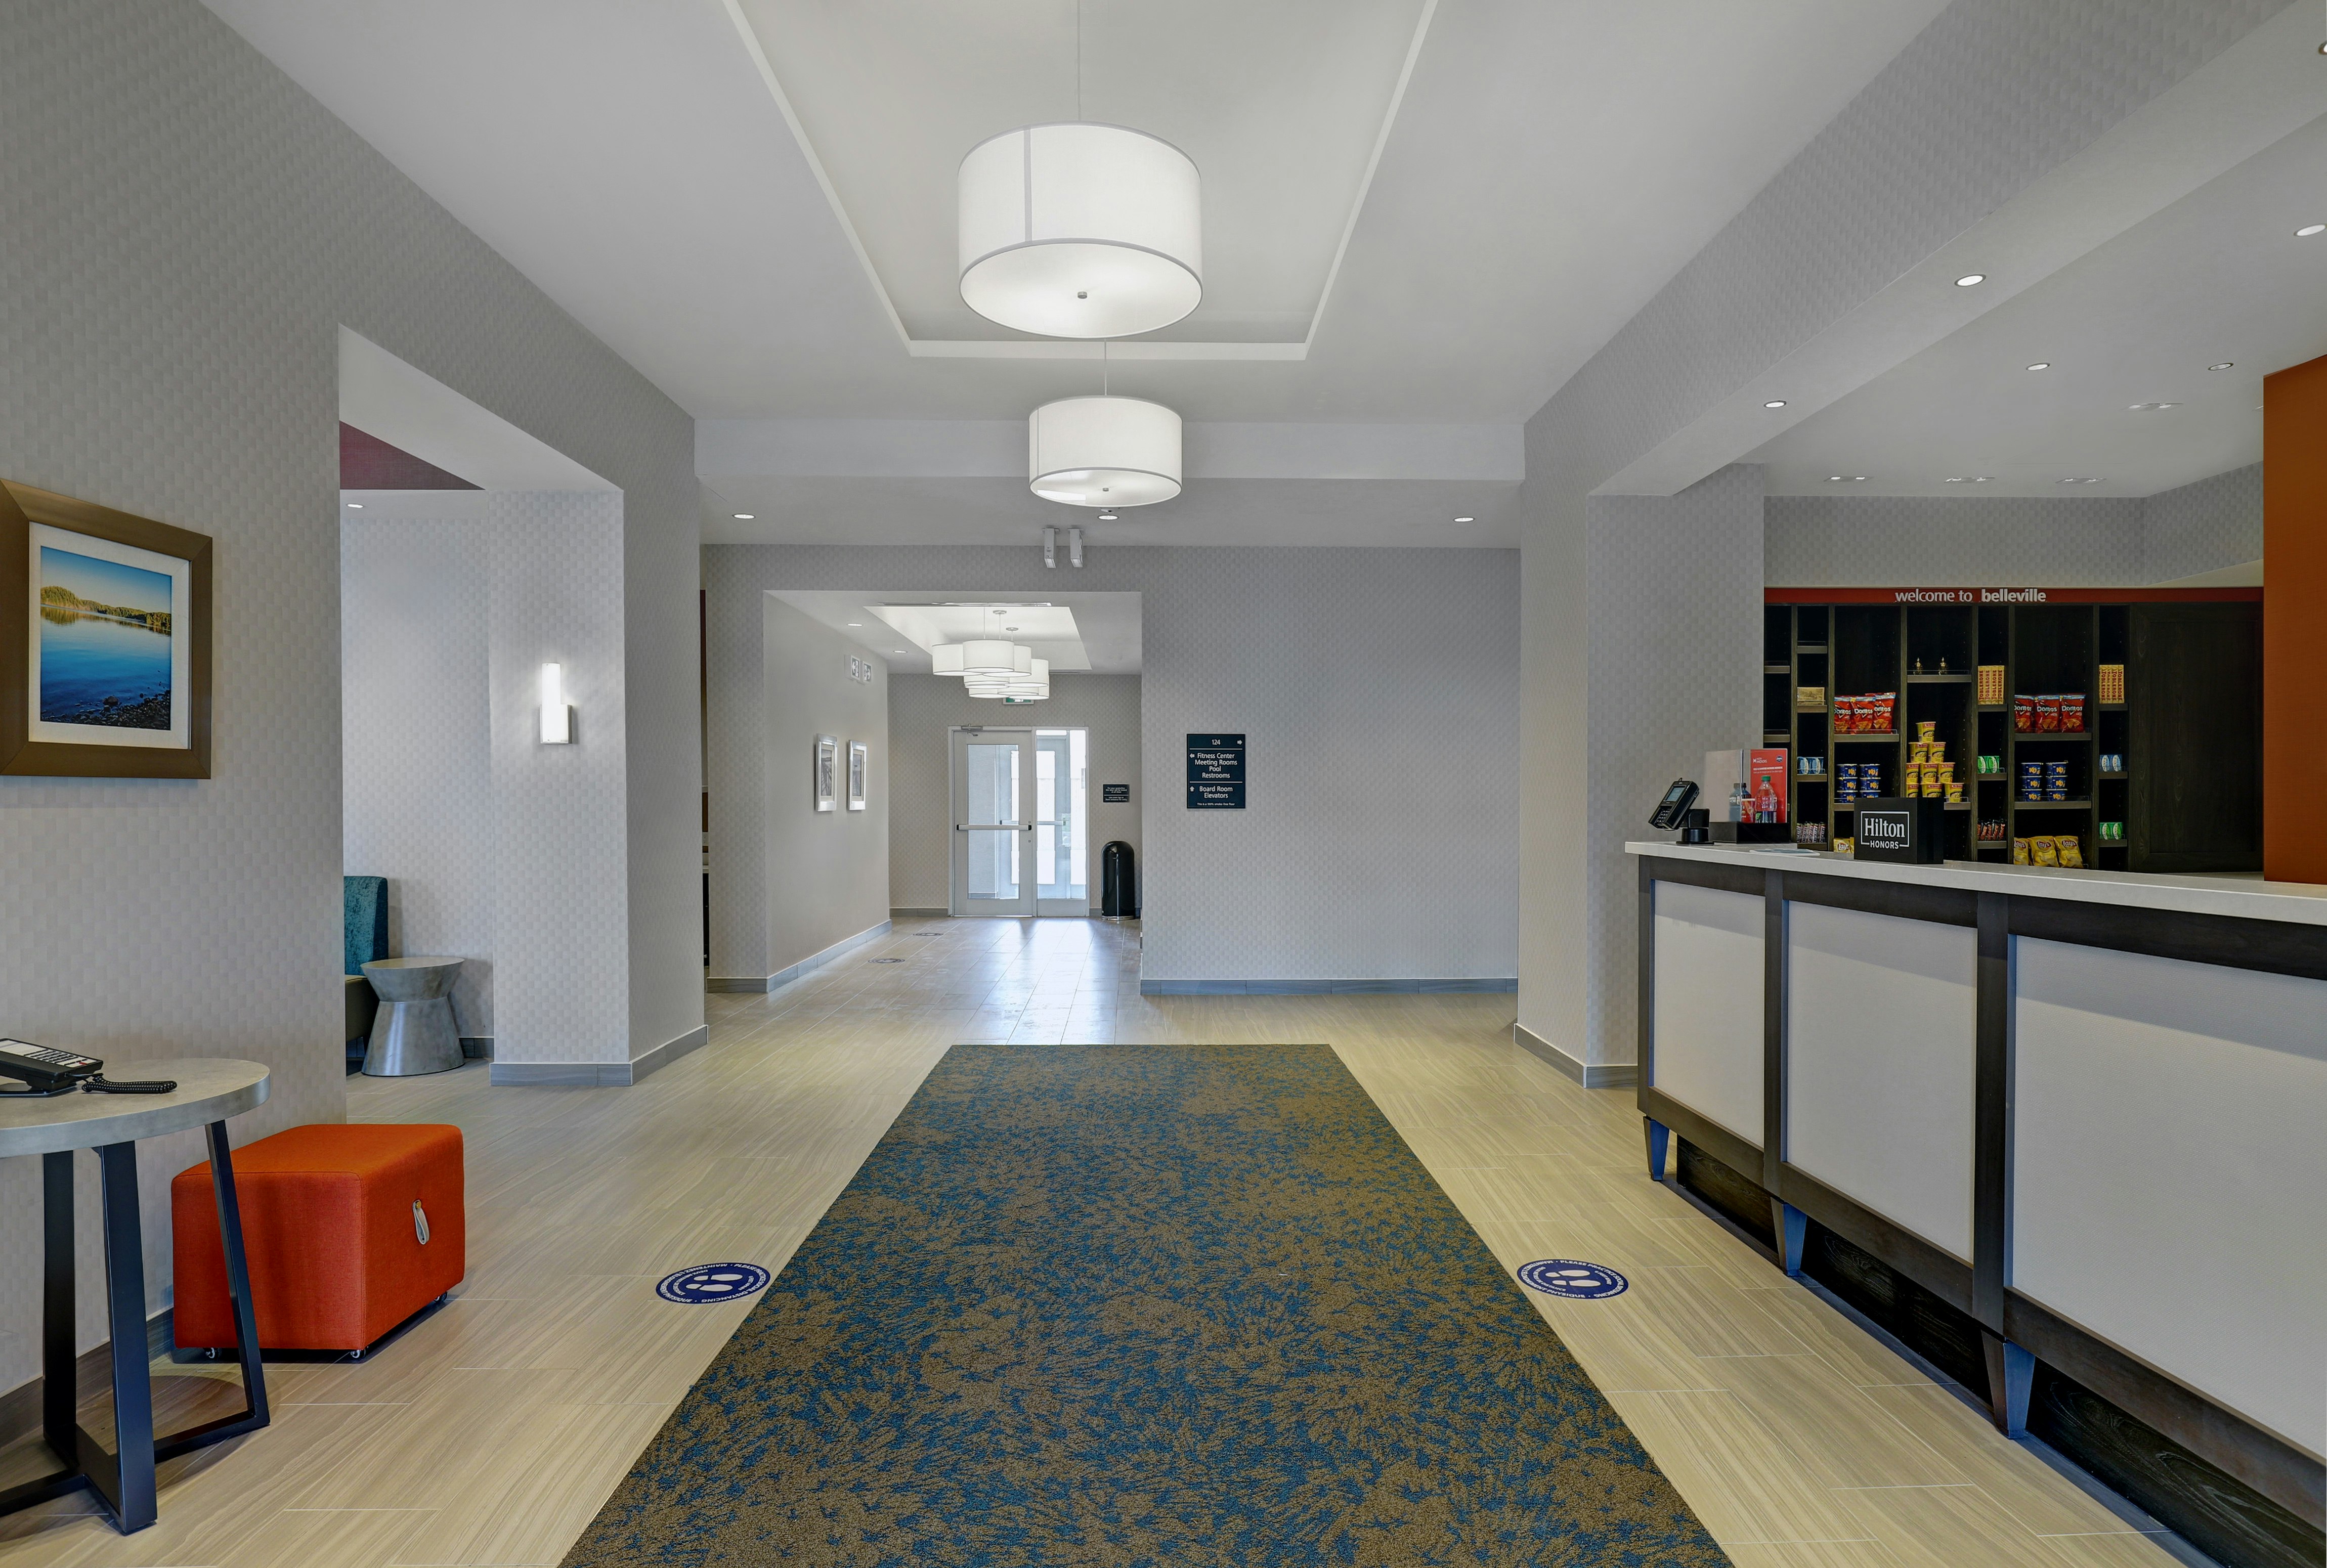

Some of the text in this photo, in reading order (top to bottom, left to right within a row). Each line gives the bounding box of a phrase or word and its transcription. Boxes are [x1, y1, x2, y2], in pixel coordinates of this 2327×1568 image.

[1895, 588, 2046, 602] welcome to belleville
[1865, 818, 1905, 837] Hilton
[1870, 840, 1899, 849] HONORS
[684, 1264, 727, 1273] MAINTENEZ
[1587, 1264, 1617, 1276] PRACTICE
[702, 1291, 748, 1302] DISTANCING
[1546, 1289, 1585, 1298] PHYSIQUE
